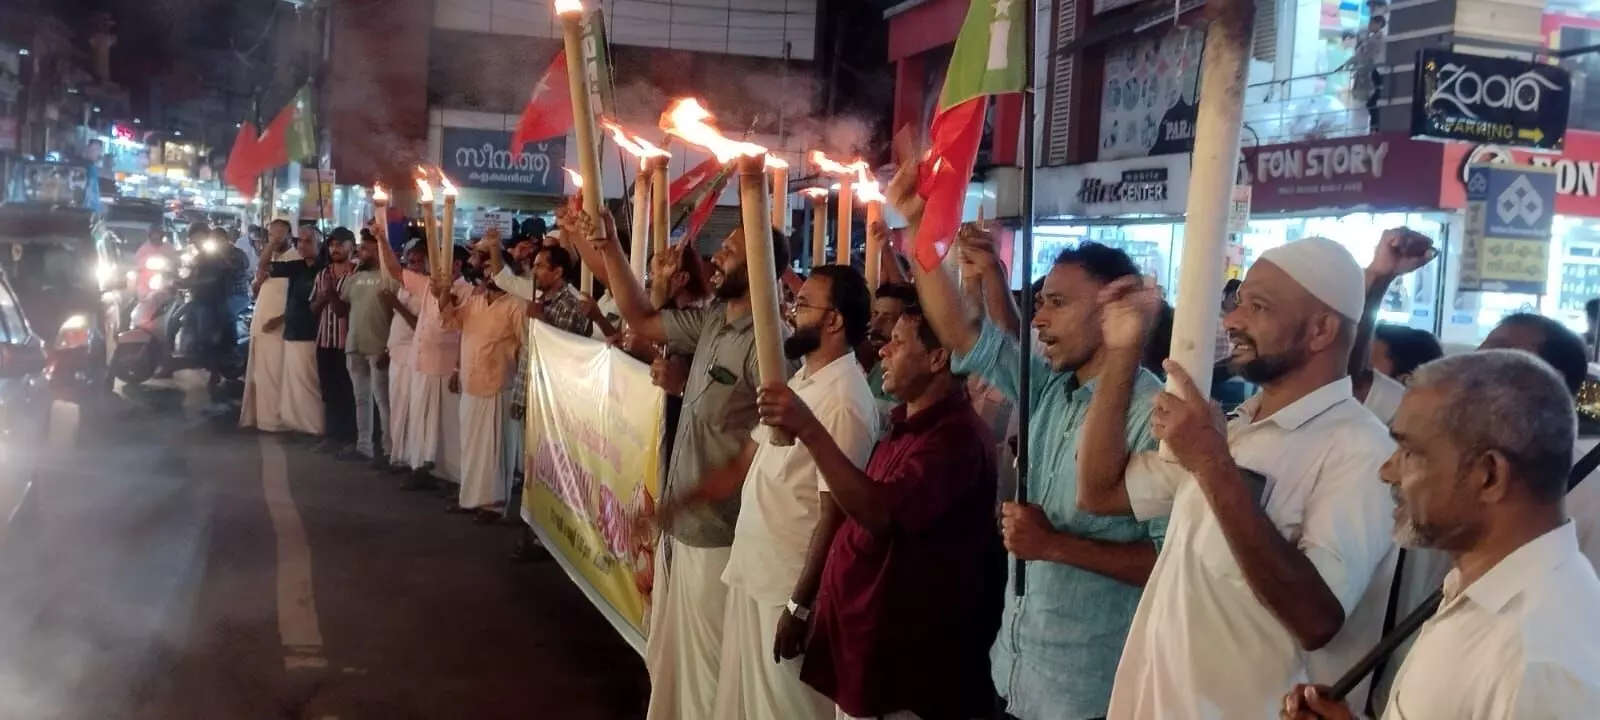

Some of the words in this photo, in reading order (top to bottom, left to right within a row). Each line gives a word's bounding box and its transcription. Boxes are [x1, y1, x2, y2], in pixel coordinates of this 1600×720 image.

[1257, 148, 1303, 183] FON
[1305, 141, 1389, 179] STORY
[1121, 181, 1165, 201] CENTER
